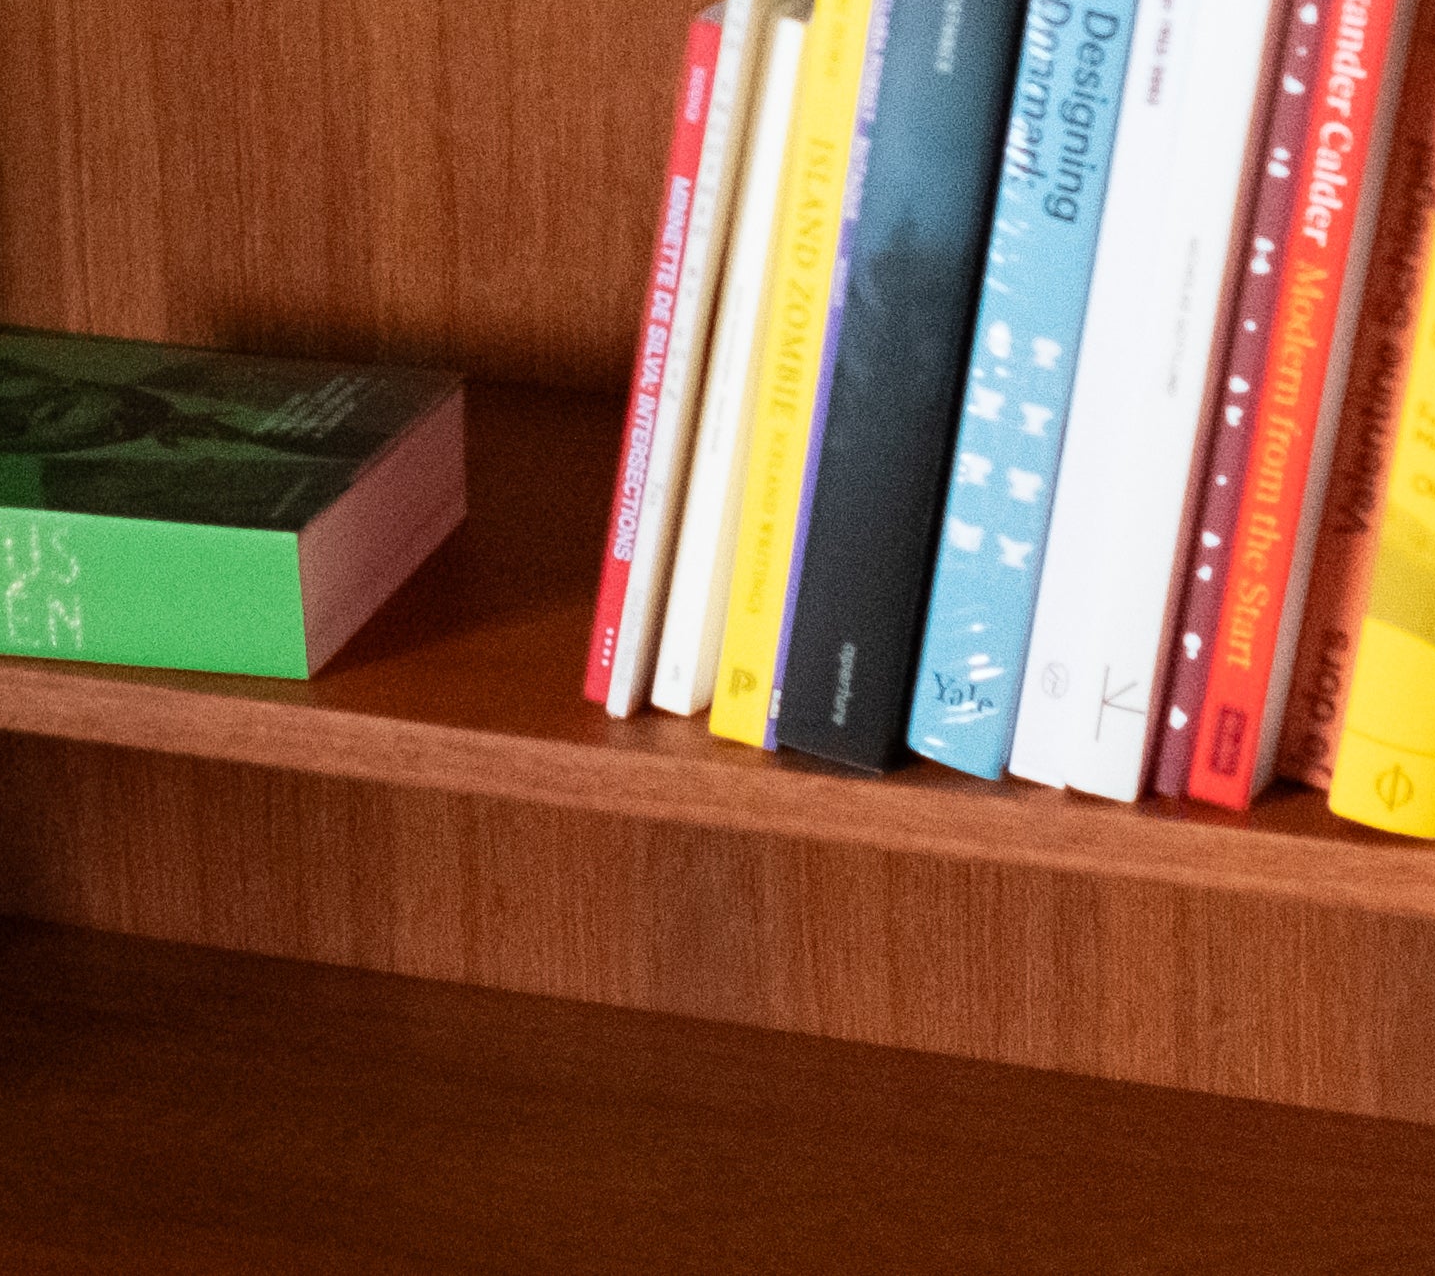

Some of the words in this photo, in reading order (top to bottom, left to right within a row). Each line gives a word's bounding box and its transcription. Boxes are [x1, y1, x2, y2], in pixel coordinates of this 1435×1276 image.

[1042, 9, 1120, 227] Designing
[656, 175, 692, 288] MINNETTE
[795, 137, 835, 269] ISLAND
[1301, 121, 1353, 247] Calder
[639, 323, 669, 391] SILVA:
[648, 290, 671, 321] DE
[771, 278, 813, 423] ZOMBIE
[1274, 259, 1330, 411] Modern
[613, 394, 659, 562] INTERSECTIONS
[1256, 415, 1302, 503] from
[1242, 515, 1282, 574] the
[1226, 583, 1270, 672] Start
[934, 671, 994, 713] Yale
